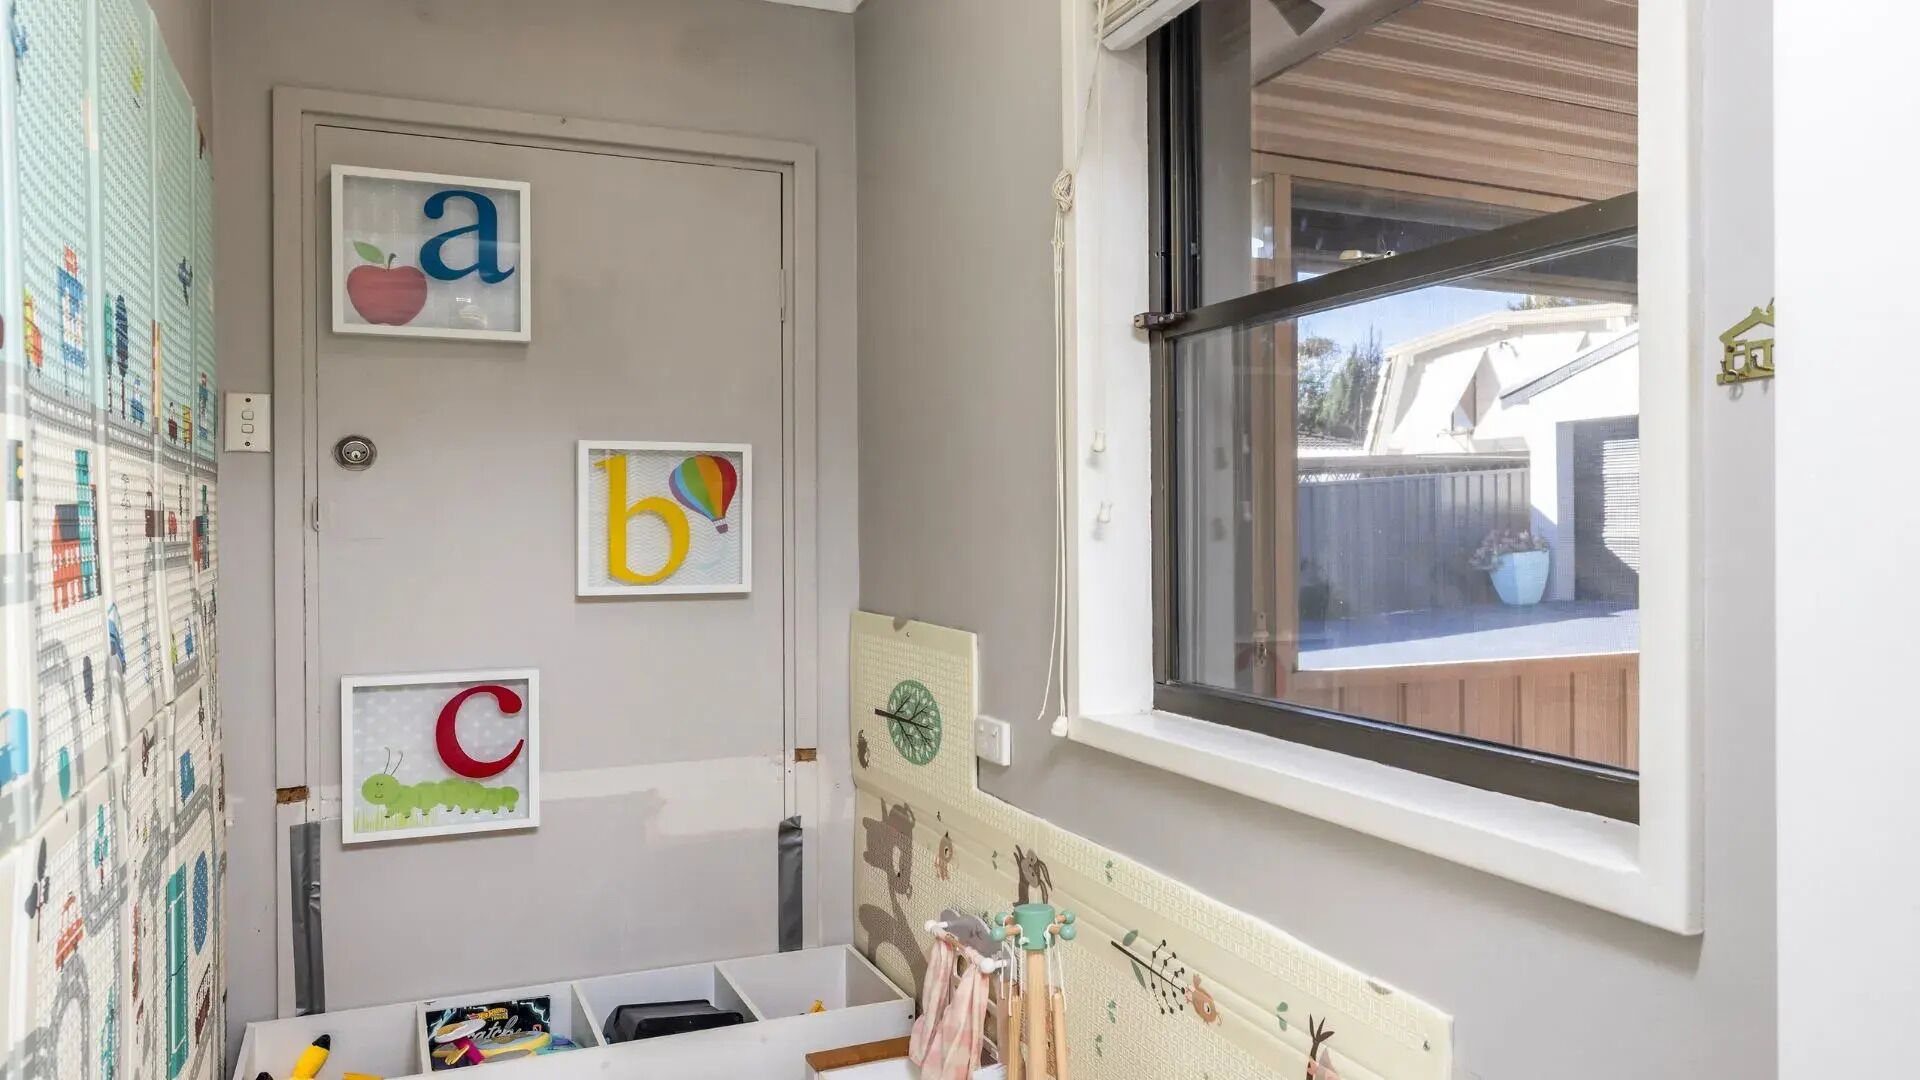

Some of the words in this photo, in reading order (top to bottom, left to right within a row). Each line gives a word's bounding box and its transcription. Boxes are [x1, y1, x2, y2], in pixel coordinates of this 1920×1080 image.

[419, 189, 515, 285] a
[594, 453, 691, 585] b
[435, 685, 525, 779] c
